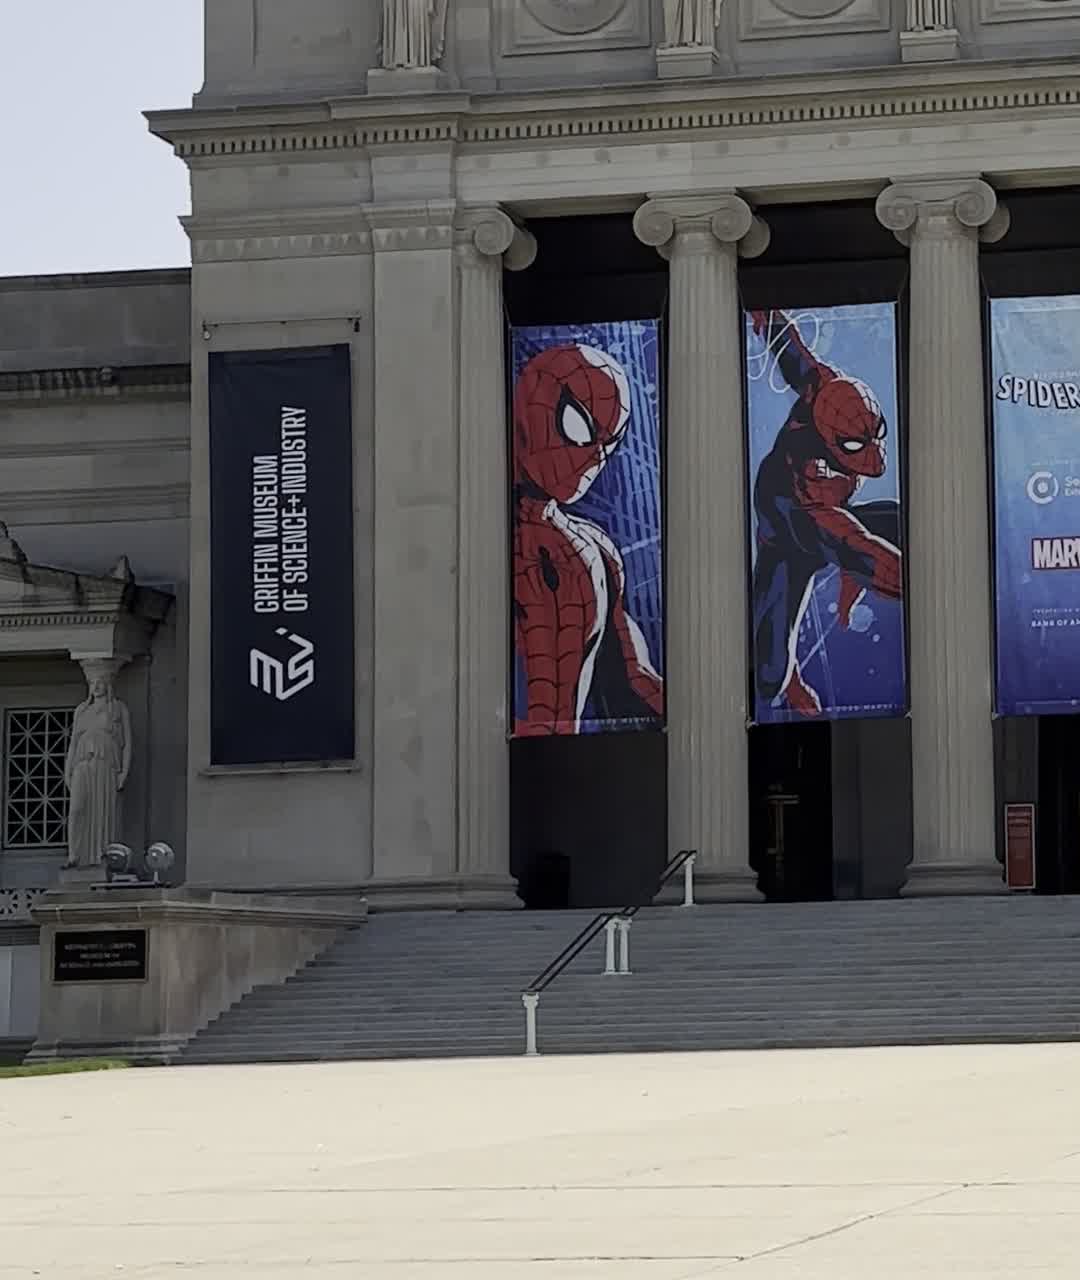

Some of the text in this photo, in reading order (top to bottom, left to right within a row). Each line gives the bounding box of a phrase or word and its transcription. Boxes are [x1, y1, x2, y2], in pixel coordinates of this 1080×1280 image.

[253, 455, 280, 613] GRIFFIN MUSEUM
[282, 589, 308, 612] OF
[1057, 618, 1068, 626] OF
